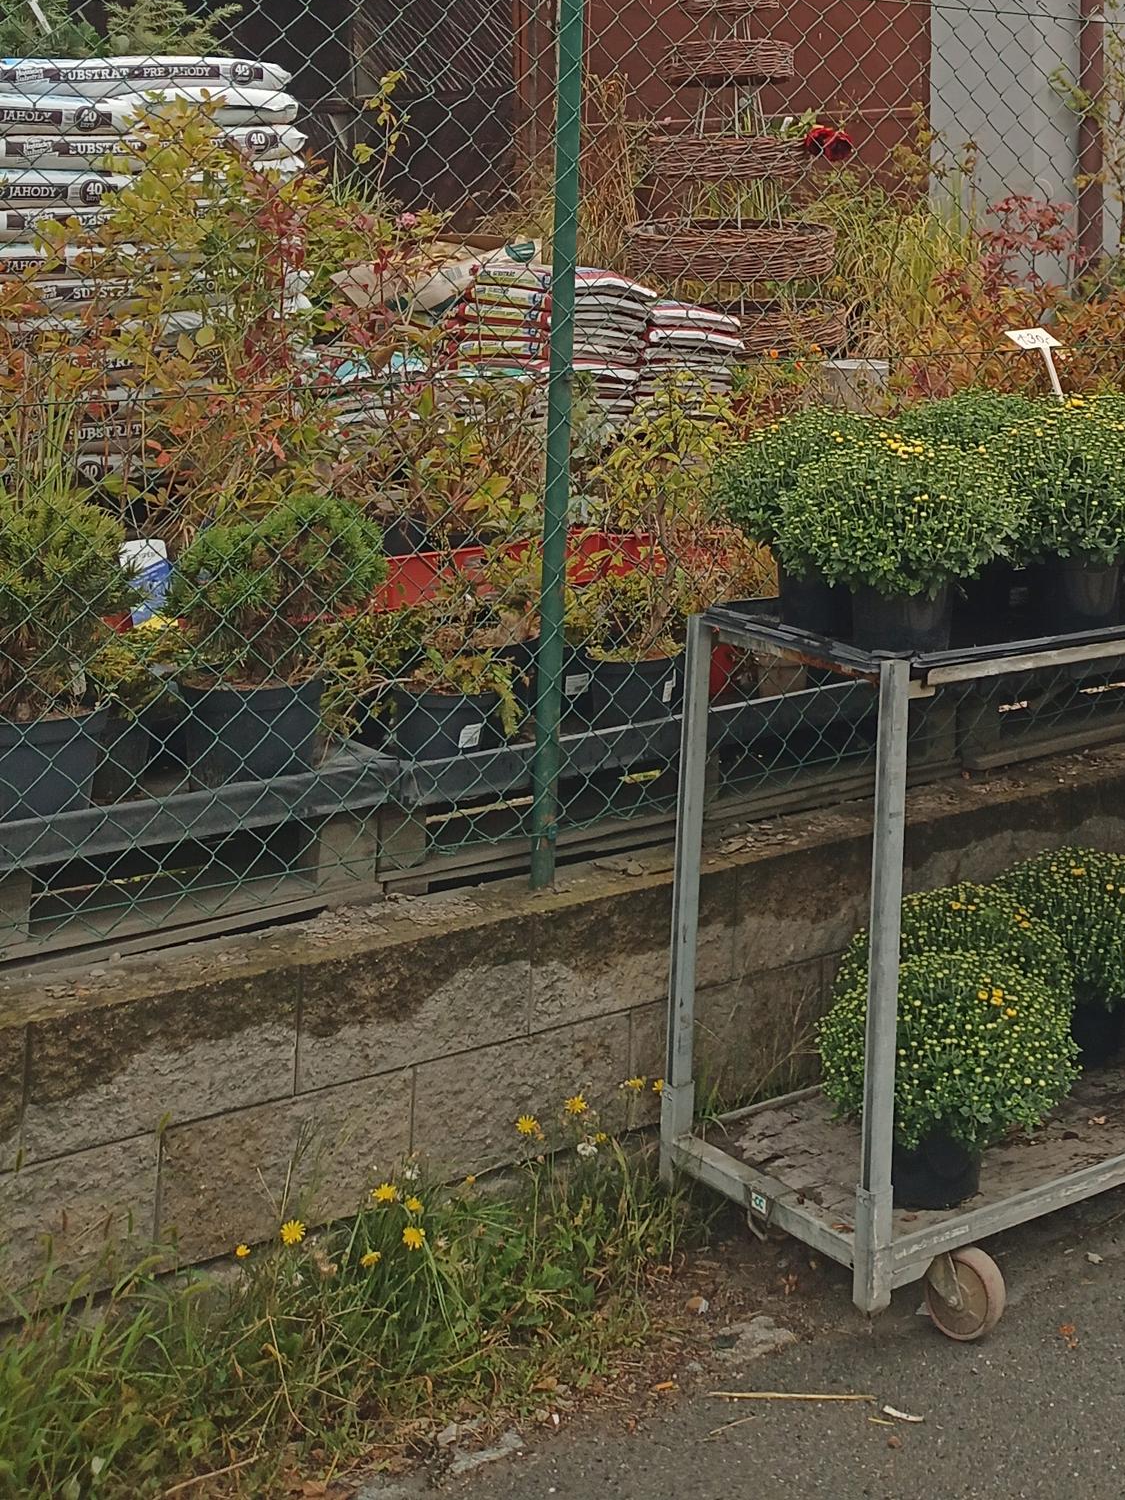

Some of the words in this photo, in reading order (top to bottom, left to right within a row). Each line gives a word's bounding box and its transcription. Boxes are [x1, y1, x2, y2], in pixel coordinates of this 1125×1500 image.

[250, 133, 264, 145] 40
[69, 141, 141, 155] SUBSTRT
[9, 186, 57, 198] JAHODY
[87, 182, 103, 195] 40
